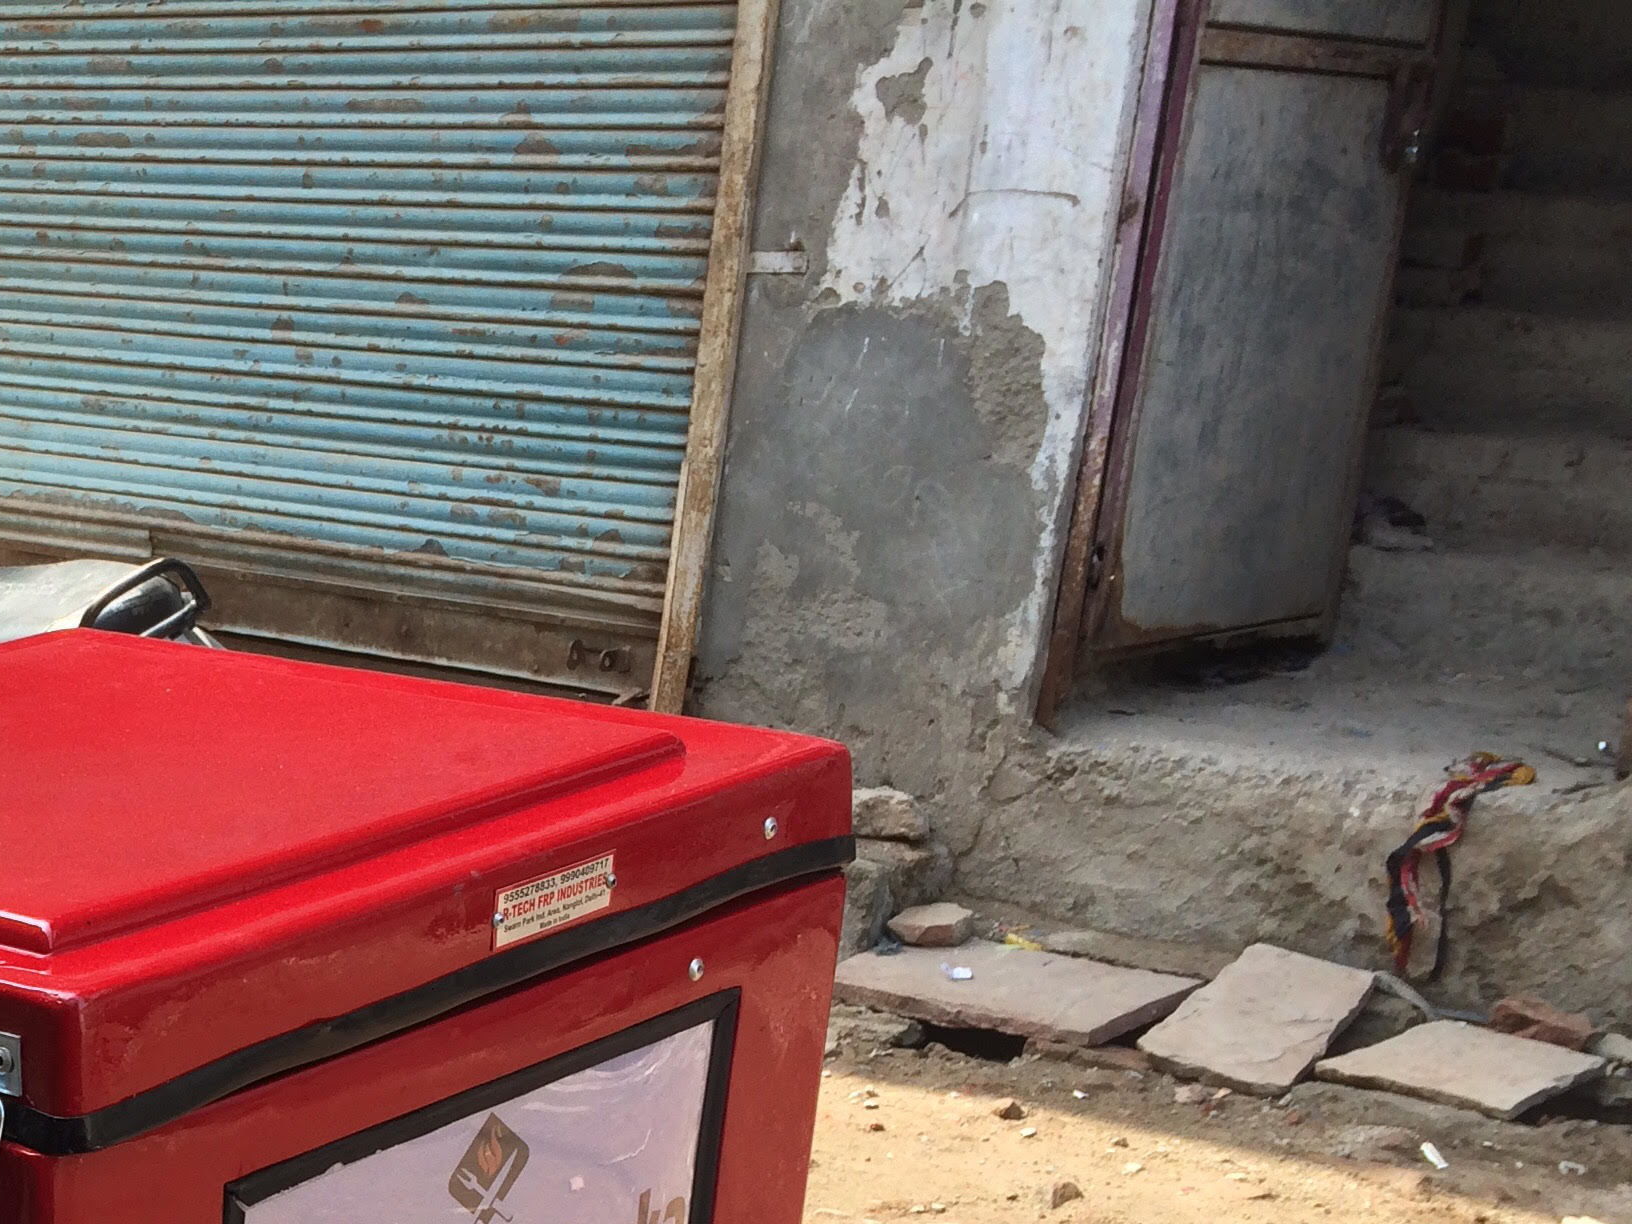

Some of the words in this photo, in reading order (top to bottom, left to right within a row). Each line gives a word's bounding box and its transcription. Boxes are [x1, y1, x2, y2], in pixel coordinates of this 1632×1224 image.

[502, 900, 535, 921] R-TECH
[537, 892, 555, 909] FRP
[557, 872, 608, 902] INDUSTRIES
[522, 914, 535, 927] Park
